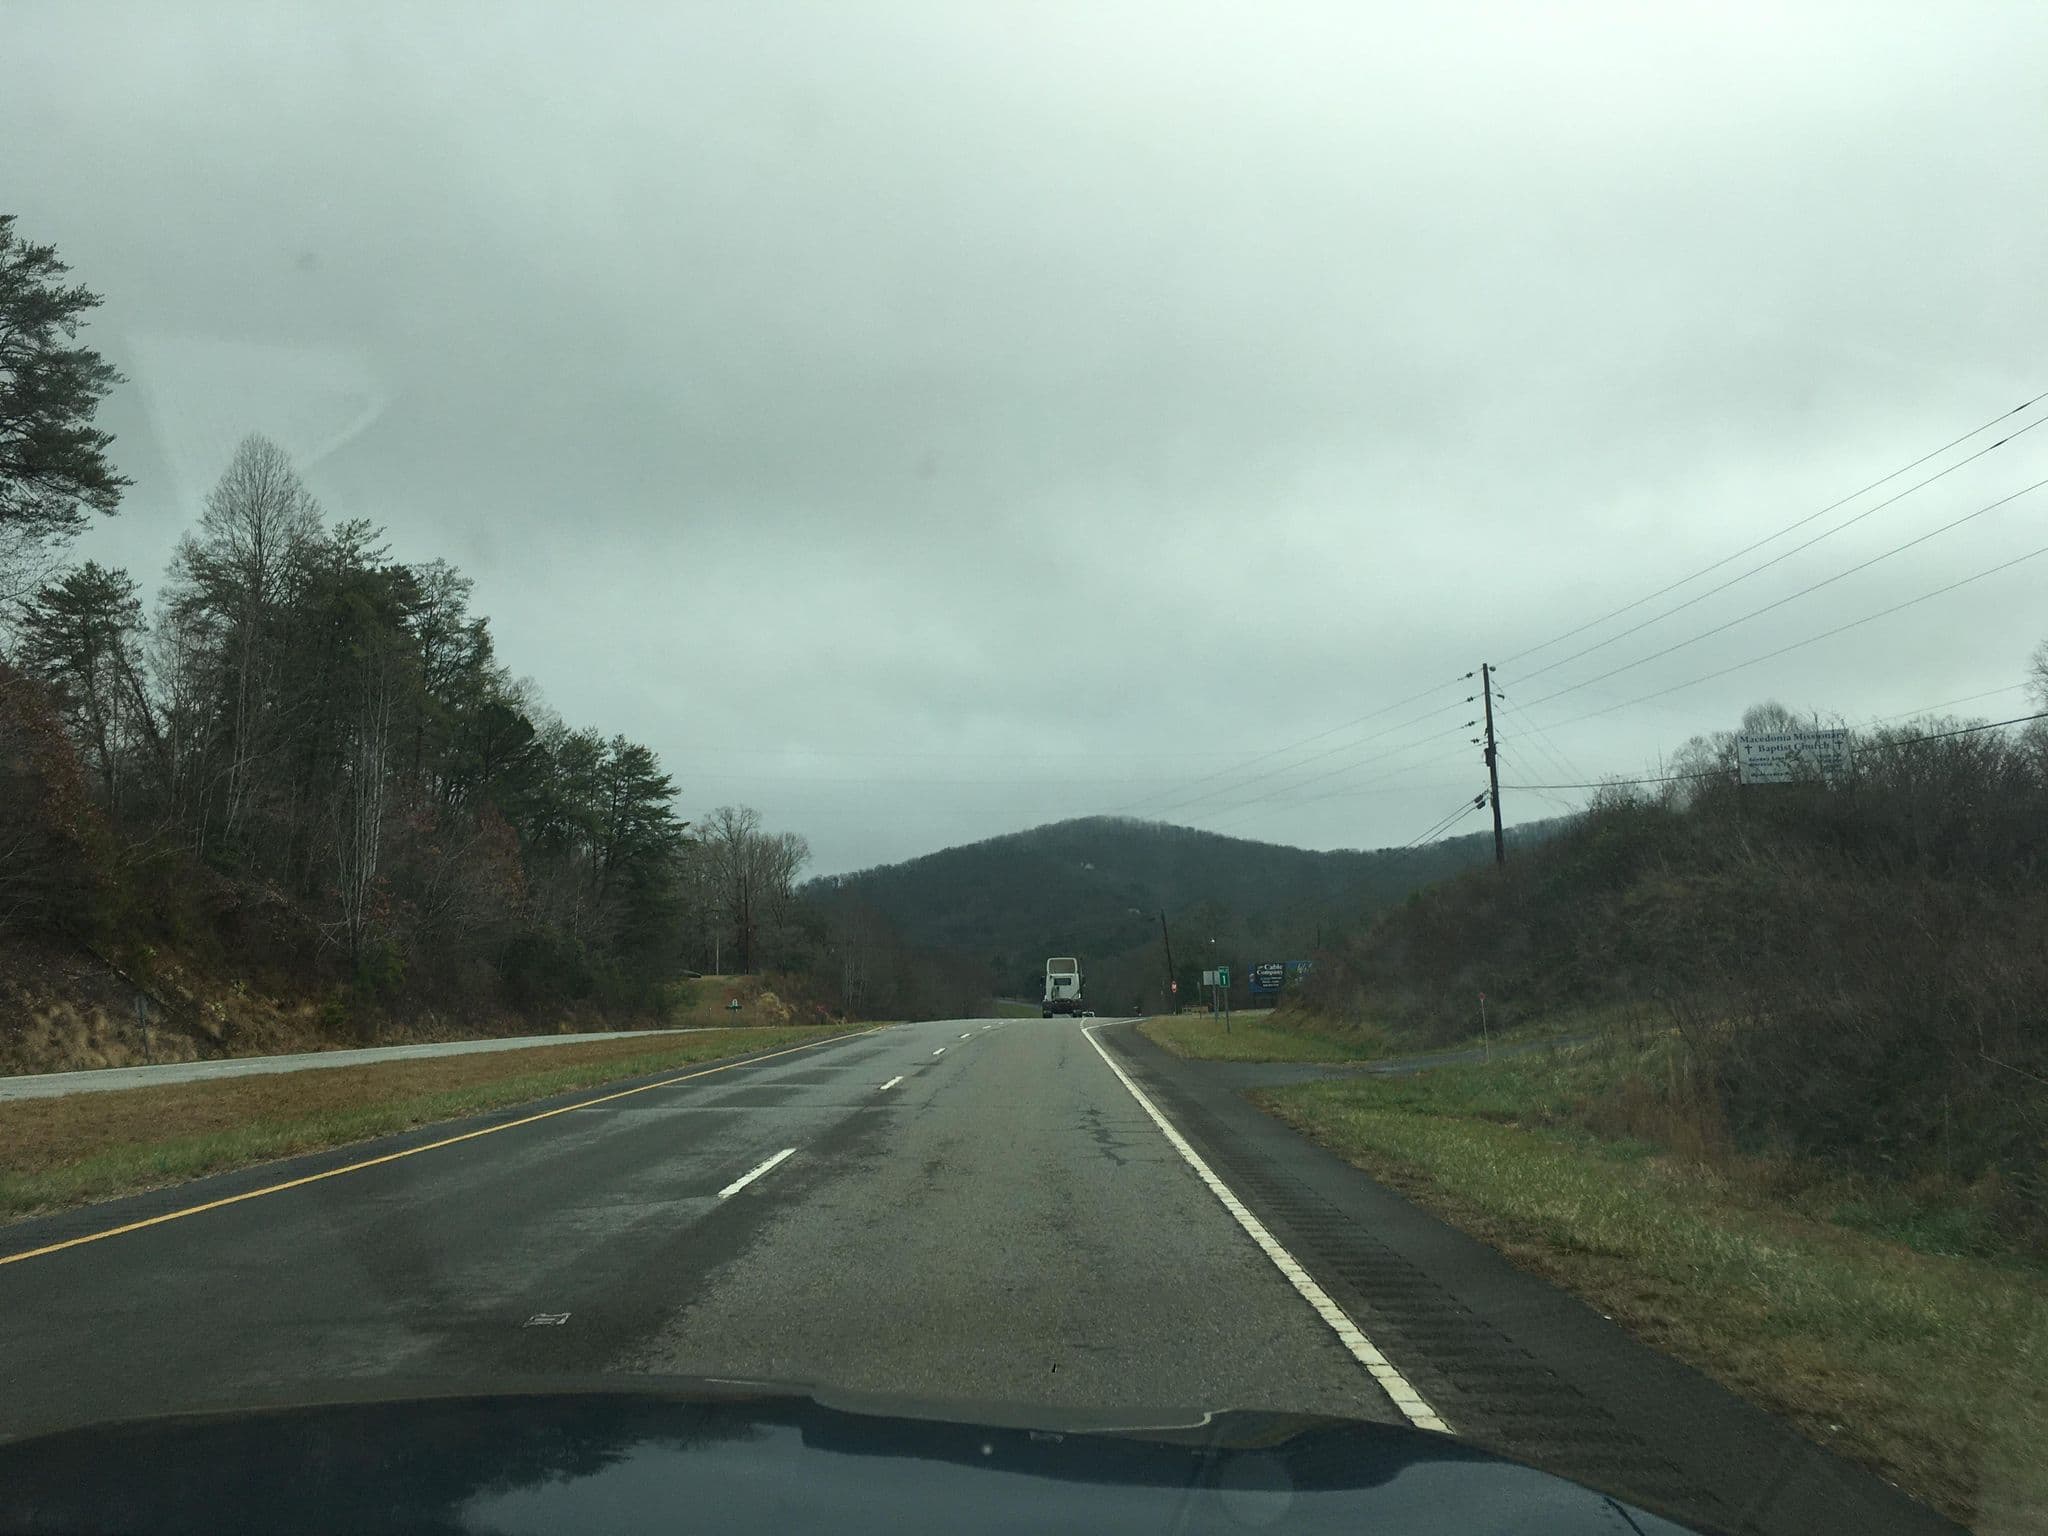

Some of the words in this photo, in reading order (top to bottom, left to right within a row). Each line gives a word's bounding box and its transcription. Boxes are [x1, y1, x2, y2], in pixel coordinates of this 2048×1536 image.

[1740, 735, 1791, 743] Macedonia
[1793, 732, 1845, 741] Missionary
[1758, 743, 1791, 753] Baptist
[1794, 741, 1830, 750] Church
